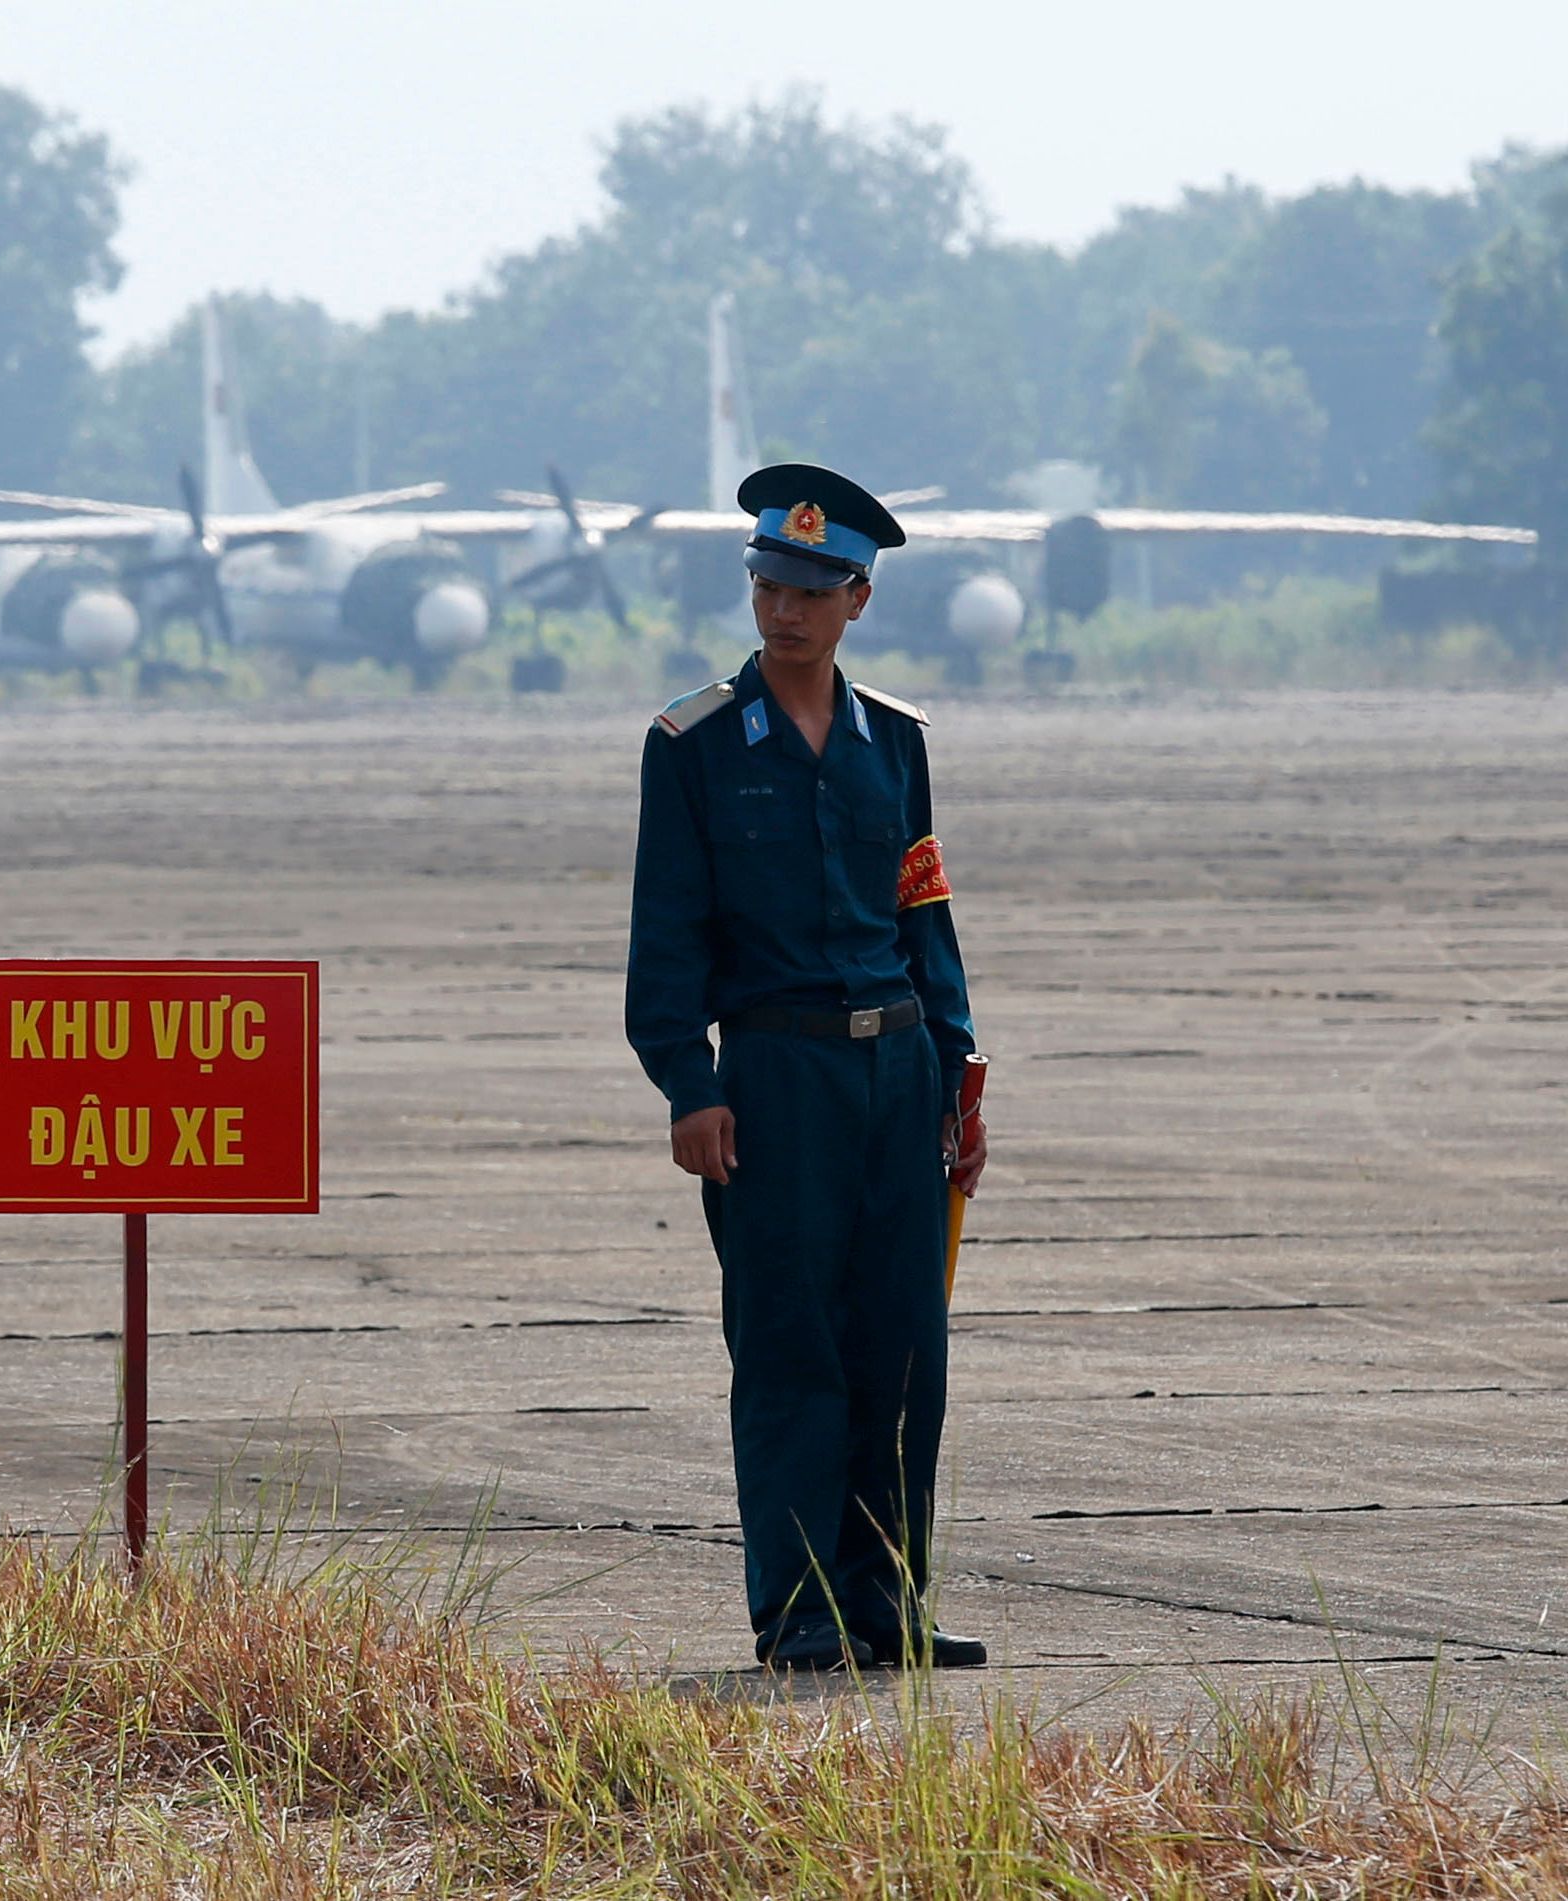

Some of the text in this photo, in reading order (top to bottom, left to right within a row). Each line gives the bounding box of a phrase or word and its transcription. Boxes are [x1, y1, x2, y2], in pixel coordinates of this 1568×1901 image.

[11, 994, 265, 1073] KHU VỰC
[29, 1094, 244, 1179] ĐẬU XE
